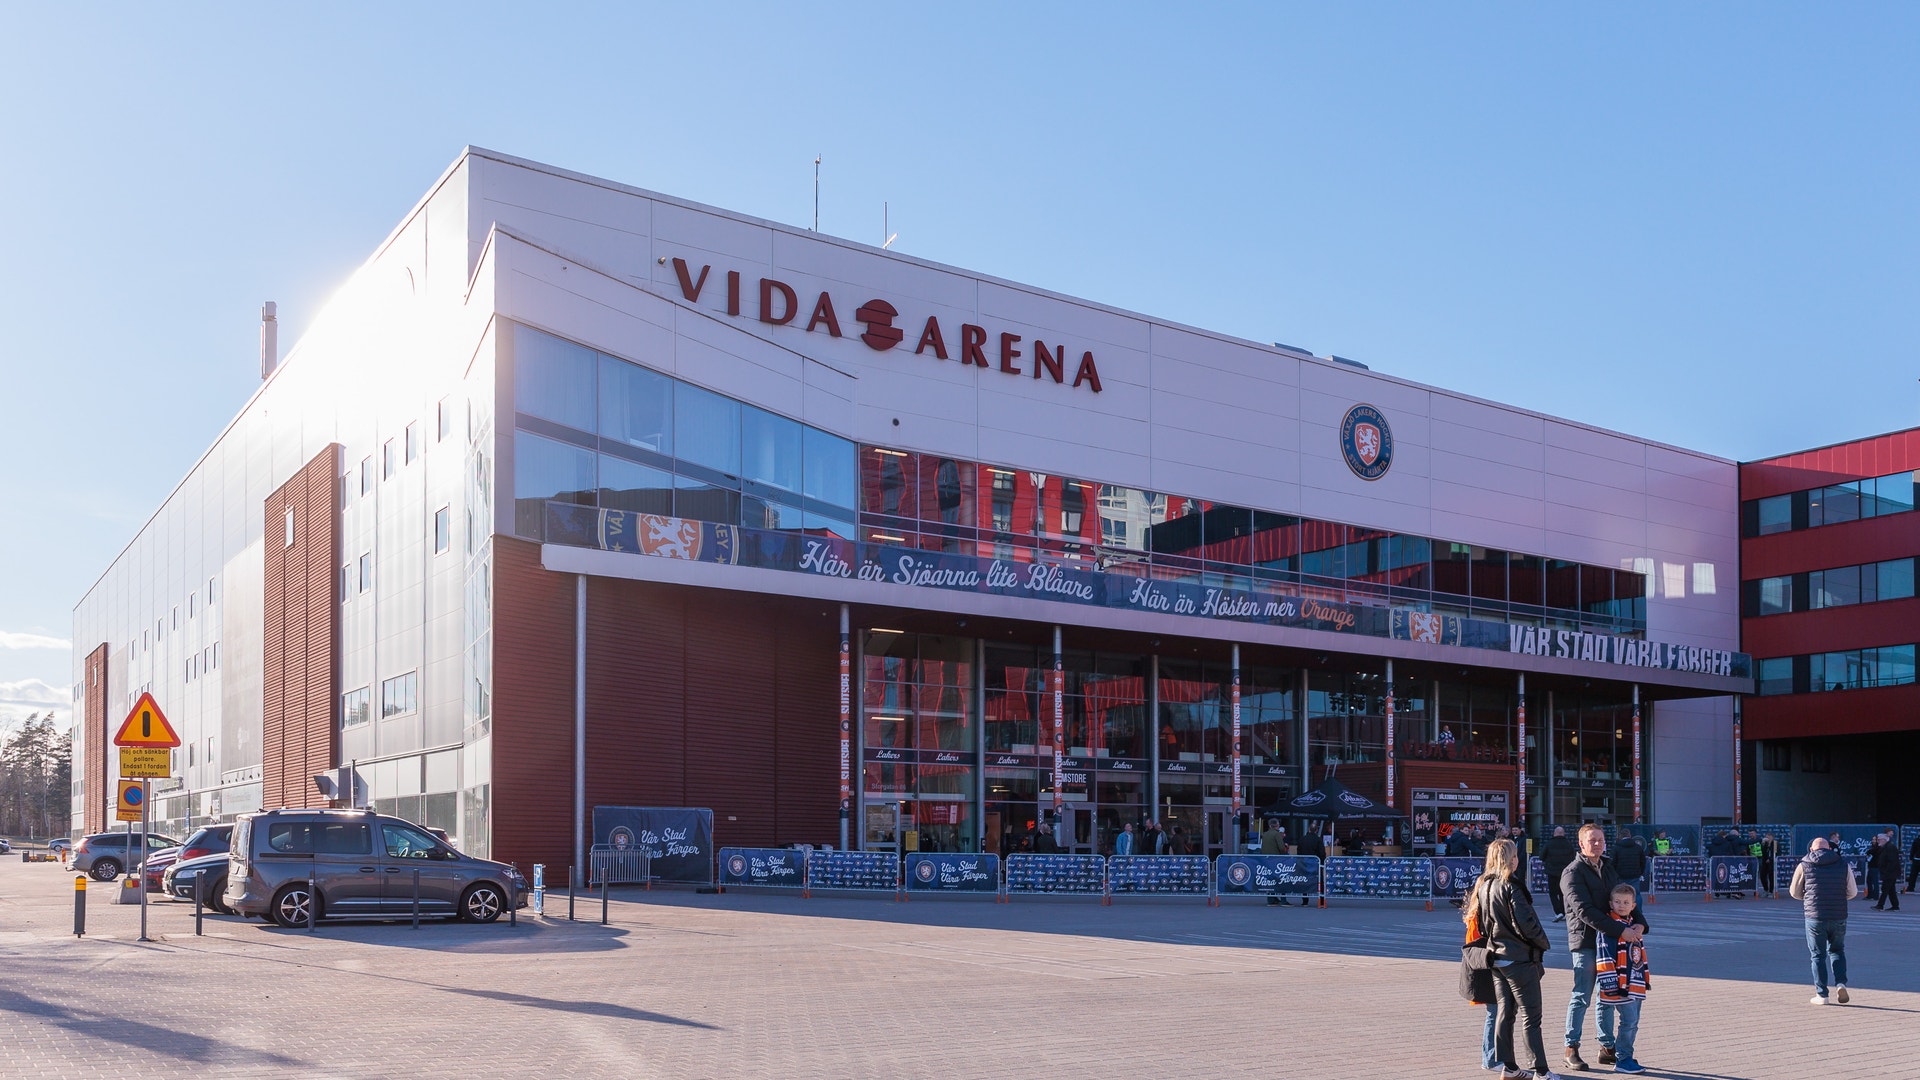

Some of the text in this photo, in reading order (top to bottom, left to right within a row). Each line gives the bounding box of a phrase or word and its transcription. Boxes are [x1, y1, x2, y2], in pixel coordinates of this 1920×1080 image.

[672, 256, 1104, 393] VIDA ARENA
[799, 540, 1094, 600] Här är Sjöarna lite Blåare
[1129, 577, 1355, 631] Här är Hösten mer Orange
[1509, 624, 1551, 657] VÅR
[1556, 630, 1608, 663] STAD
[1667, 643, 1732, 677] FÄRGER
[875, 750, 901, 759] Lakers
[935, 752, 959, 762] Lakers
[997, 756, 1020, 765] Lakers
[1060, 758, 1078, 767] akers
[1112, 760, 1133, 770] Lakers
[1167, 763, 1187, 772] Lakers
[1268, 766, 1286, 775] Lakers
[1048, 772, 1087, 783] TMSTORE
[1450, 812, 1471, 821] VÄXJÖ
[641, 827, 687, 845] Vår Stad
[665, 841, 700, 858] Färger
[767, 855, 786, 865] Stad
[958, 860, 977, 871] Stad
[1256, 862, 1296, 876] Vår Stad
[962, 870, 988, 882] Färger
[1255, 873, 1308, 886] Våra Färger
